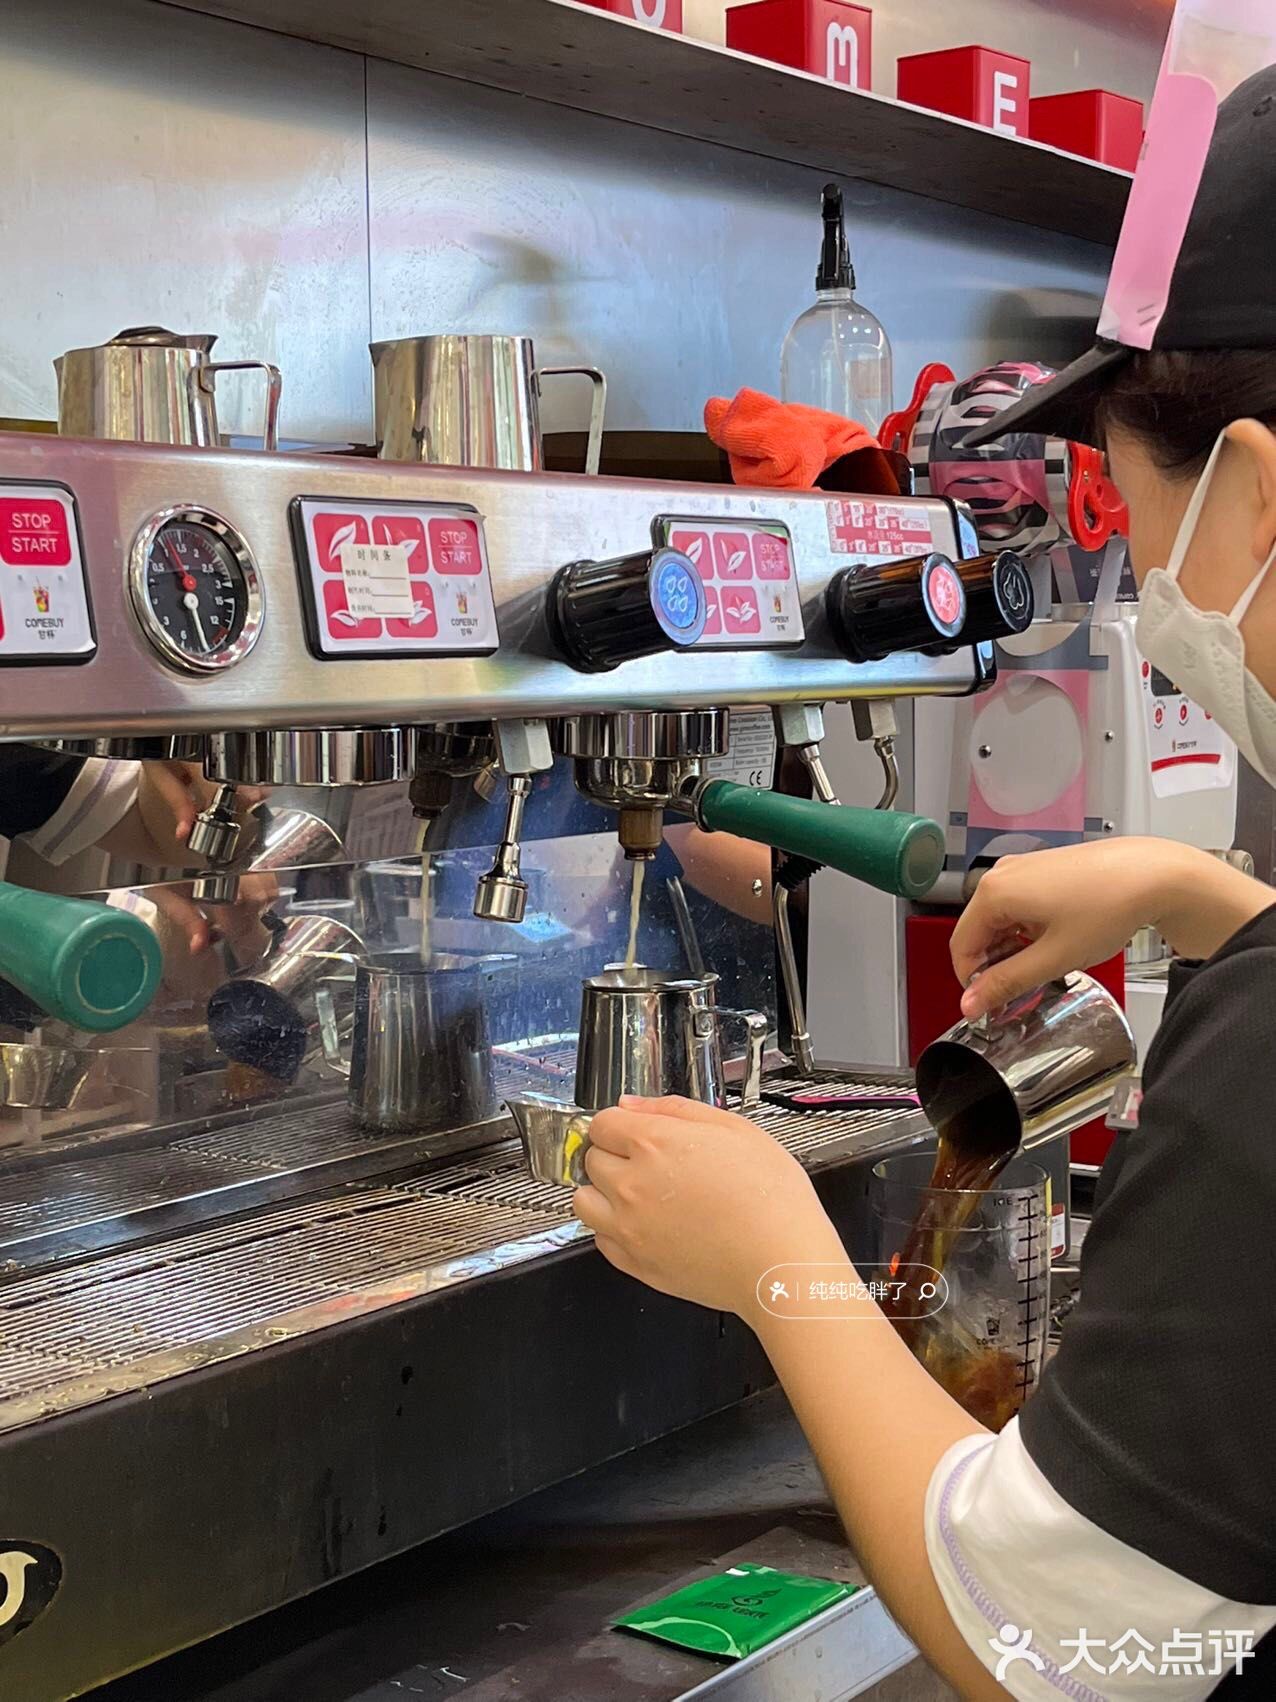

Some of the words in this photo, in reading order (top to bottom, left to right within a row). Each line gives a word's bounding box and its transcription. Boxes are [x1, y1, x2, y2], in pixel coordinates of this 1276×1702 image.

[993, 71, 1017, 136] E
[12, 513, 51, 528] STOP
[440, 531, 467, 544] STOP
[12, 537, 58, 553] START
[440, 551, 472, 564] START
[25, 618, 64, 628] COMEBUY
[451, 618, 479, 627] COMEBUY
[749, 770, 763, 787] CE
